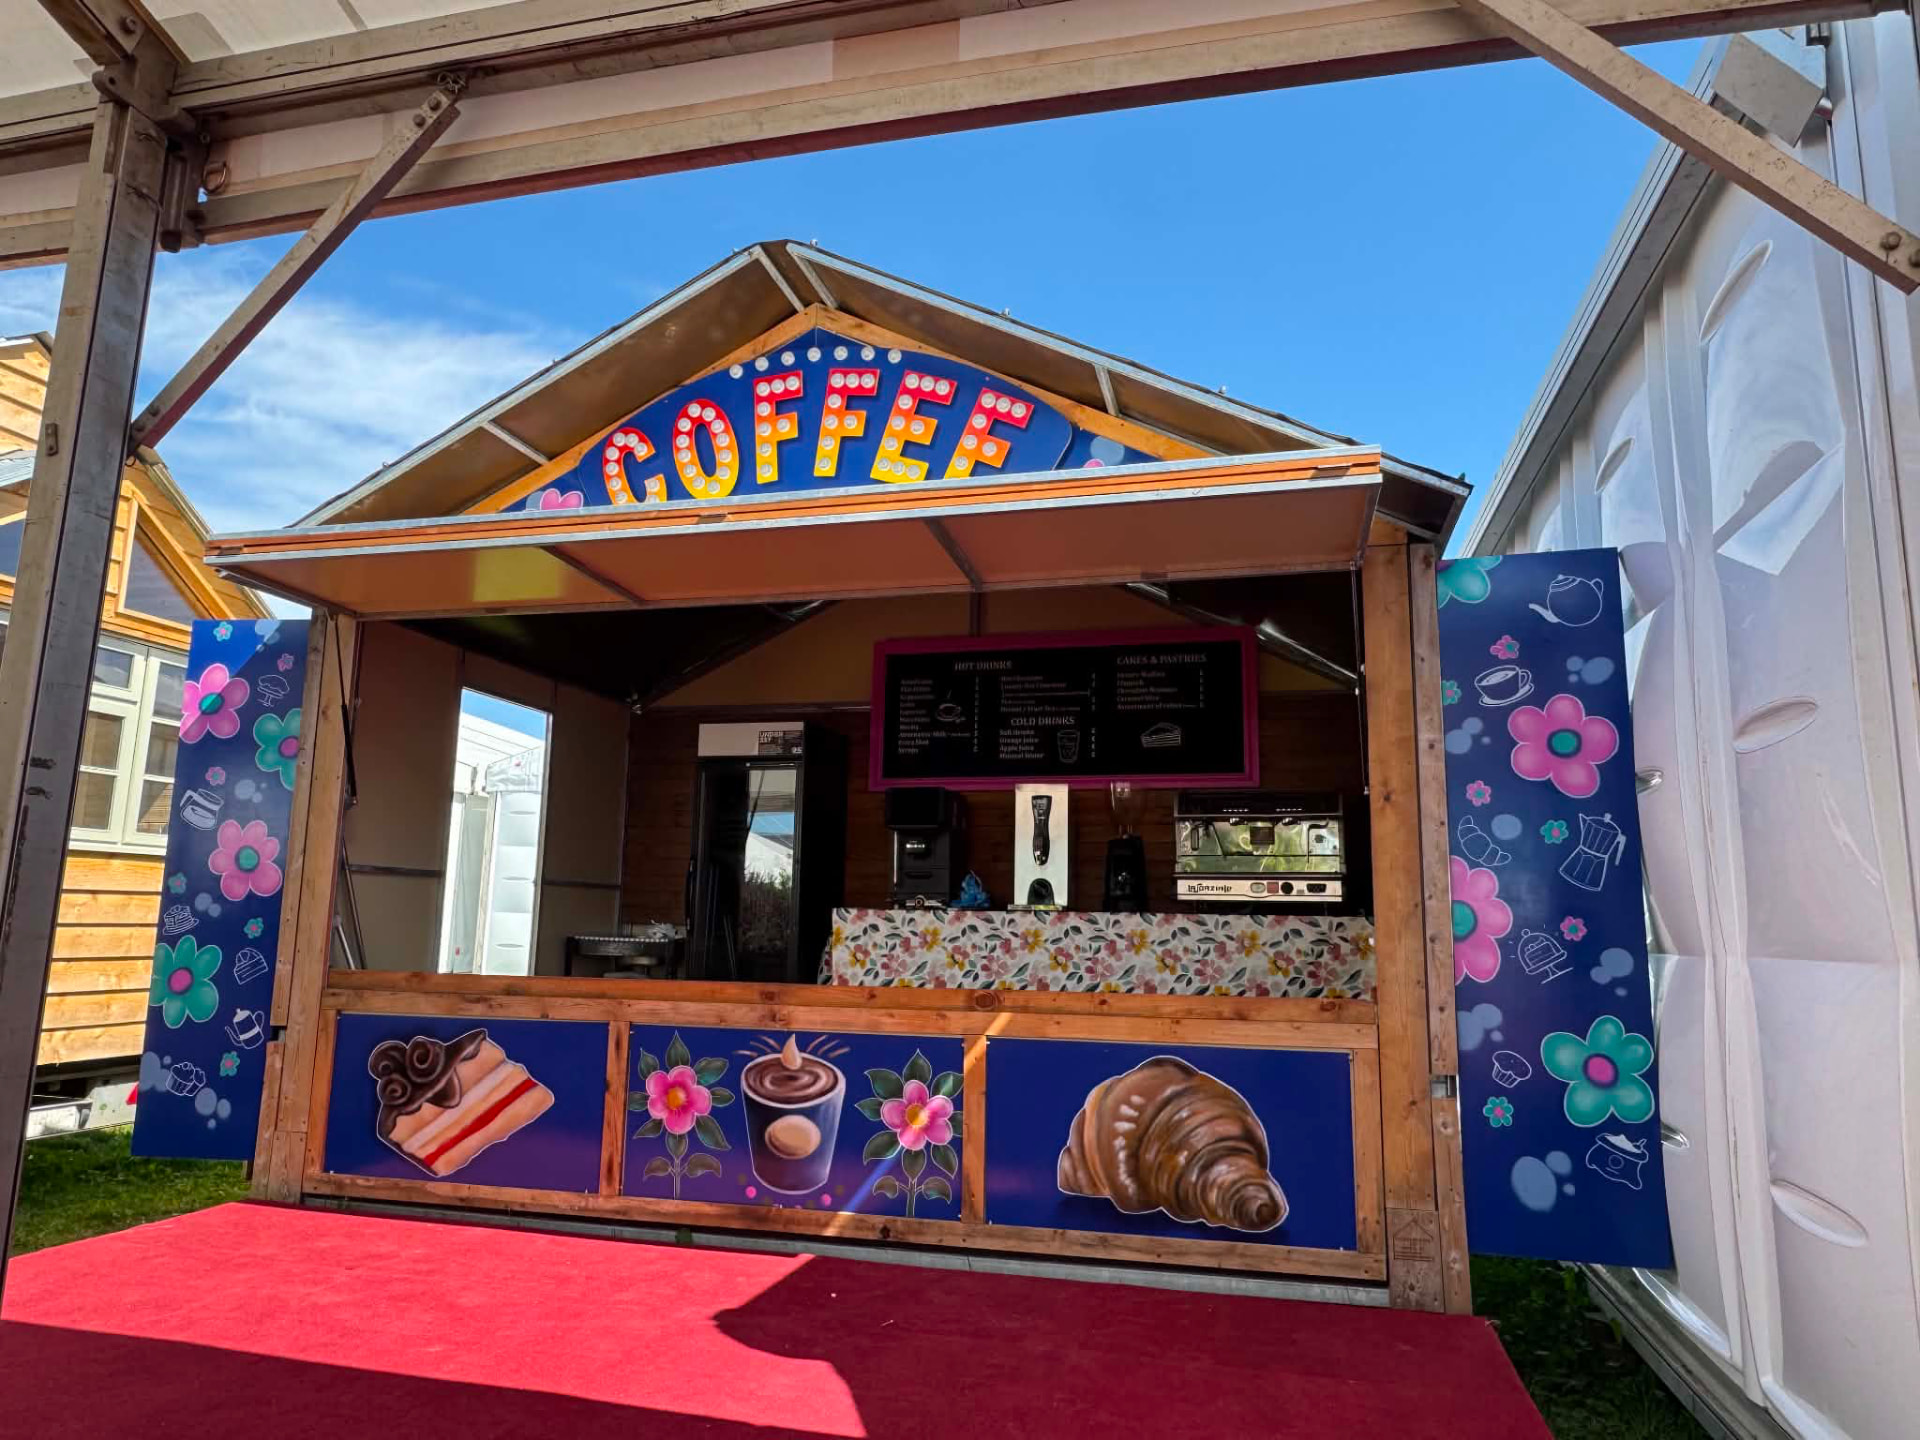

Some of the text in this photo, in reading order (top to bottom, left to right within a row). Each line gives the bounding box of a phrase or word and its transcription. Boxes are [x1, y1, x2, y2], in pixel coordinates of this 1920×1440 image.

[602, 368, 1035, 506] COFFEE
[1117, 655, 1148, 665] CAKES
[1160, 653, 1207, 664] PASTRIES
[954, 660, 1012, 671] HOT DRINKS
[1010, 716, 1075, 726] COLD DRINKS
